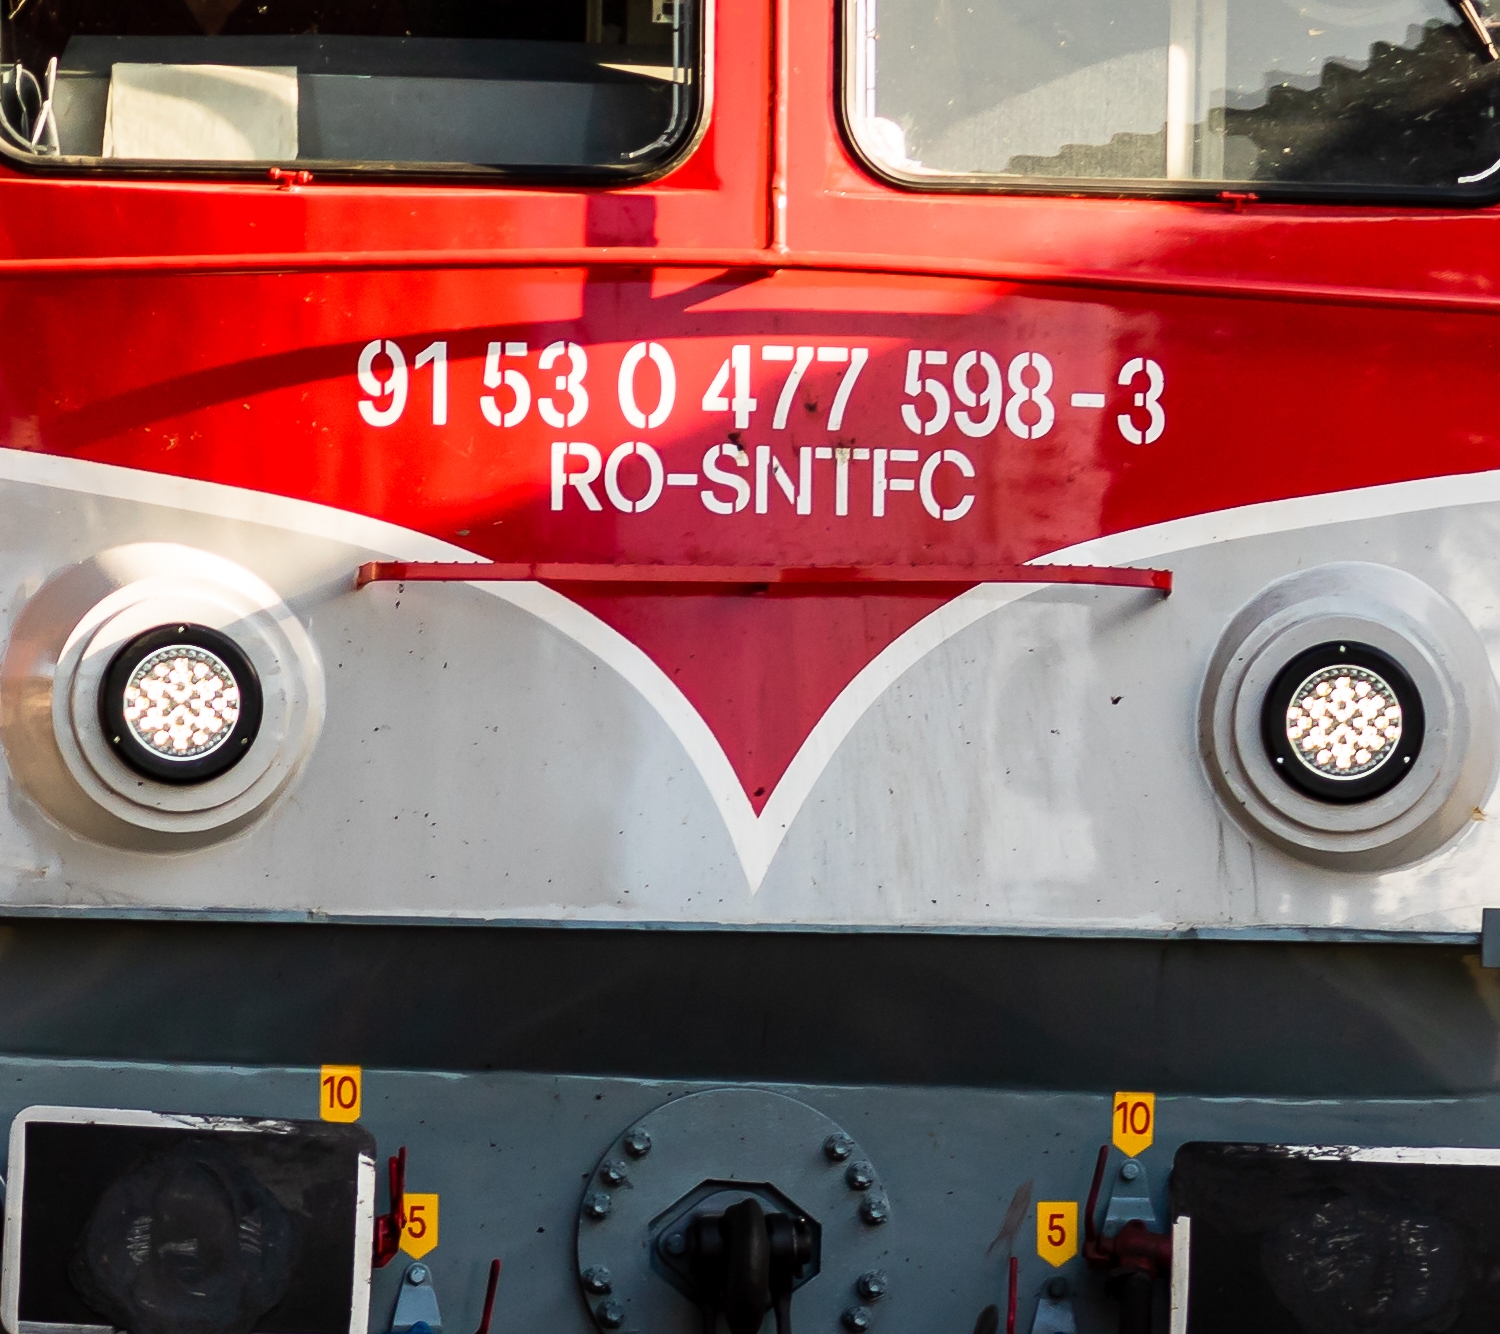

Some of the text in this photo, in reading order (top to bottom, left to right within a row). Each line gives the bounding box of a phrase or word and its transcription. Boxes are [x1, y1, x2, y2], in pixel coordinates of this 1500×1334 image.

[357, 339, 448, 427] 91
[479, 341, 589, 429] 53
[617, 341, 677, 429] 0
[701, 344, 869, 431] 477
[550, 441, 976, 521] RO-SNTFC
[322, 1075, 358, 1110] 10
[1115, 1101, 1151, 1135] 10
[407, 1205, 427, 1239] 5
[1046, 1213, 1067, 1247] 5
